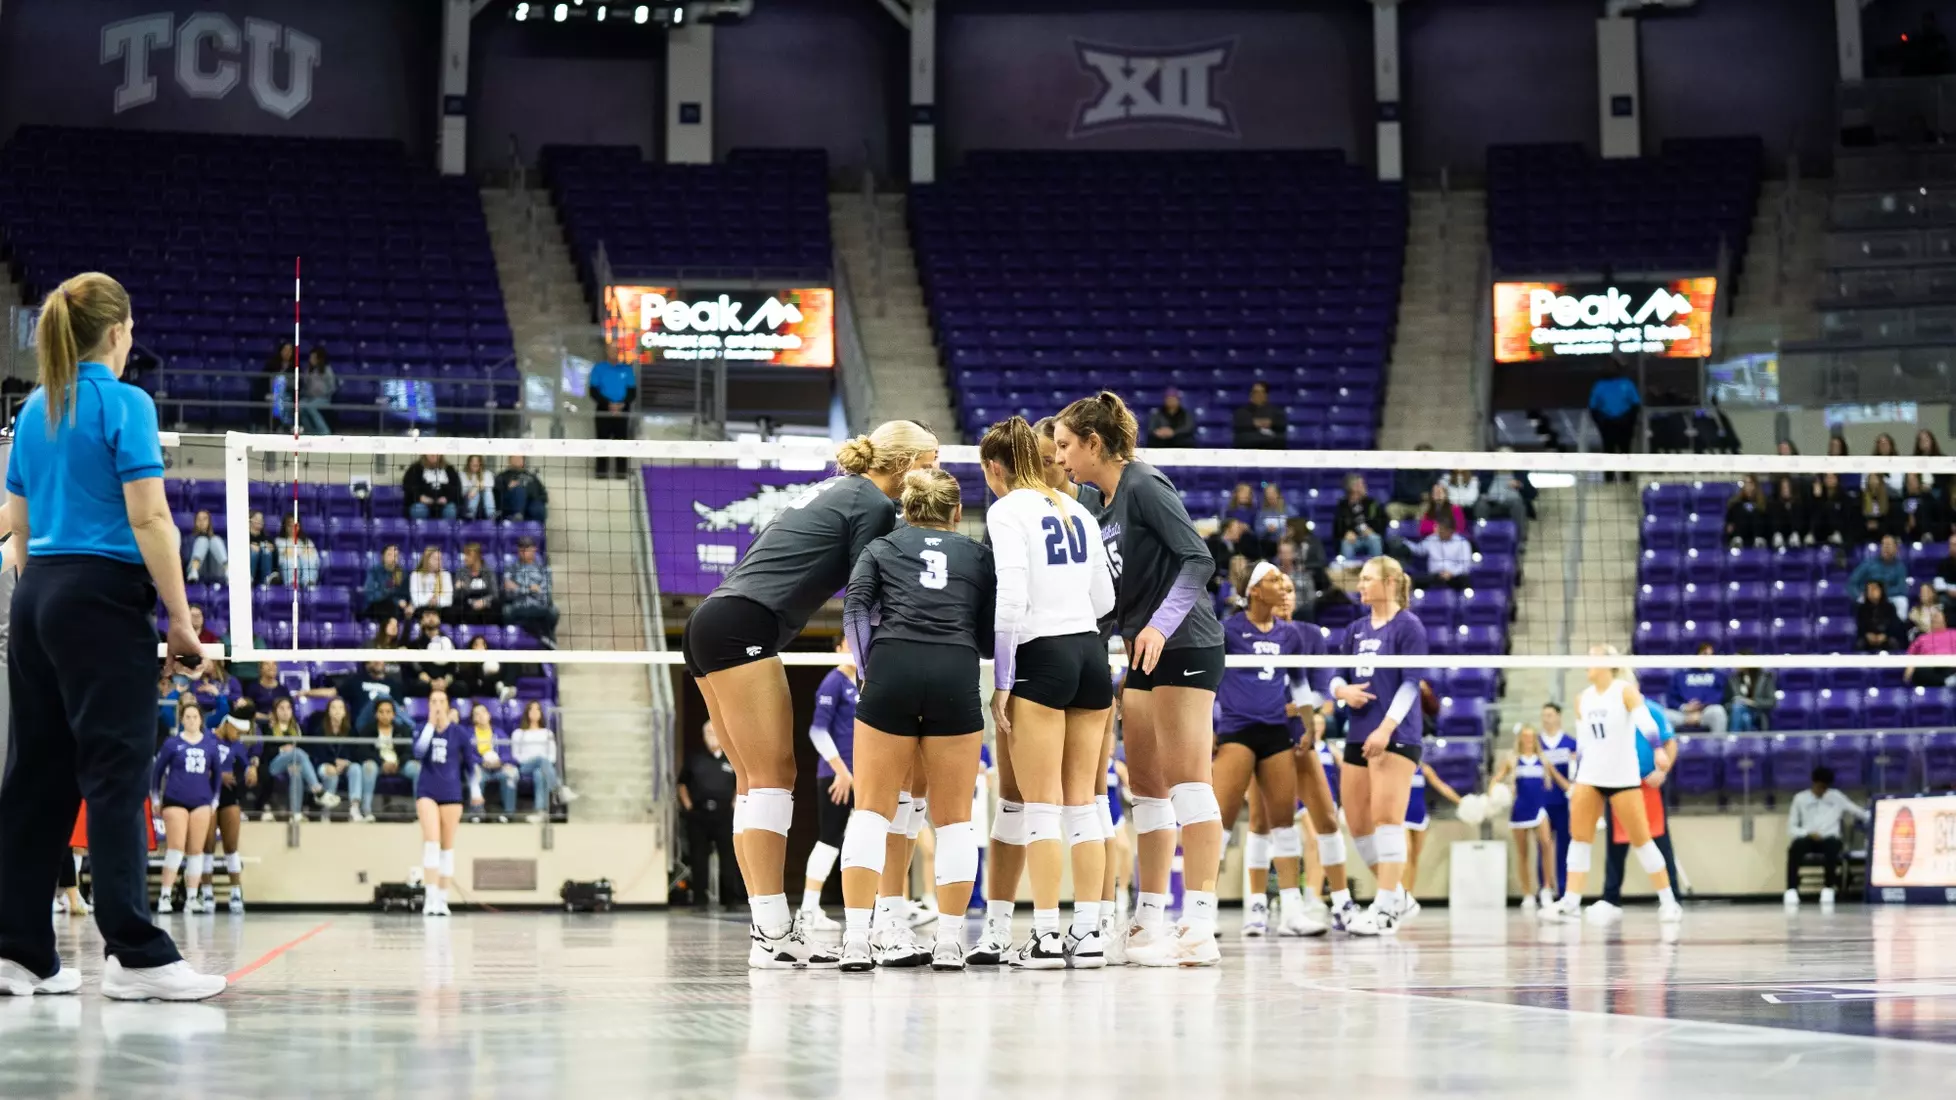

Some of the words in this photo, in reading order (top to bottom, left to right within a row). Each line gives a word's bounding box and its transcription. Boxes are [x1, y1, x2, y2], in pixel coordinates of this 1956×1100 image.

[100, 11, 321, 119] TCU
[640, 293, 743, 332] Peak
[1530, 287, 1634, 327] Peak
[1041, 515, 1088, 565] 20
[919, 549, 948, 590] 3
[1591, 722, 1606, 740] 11
